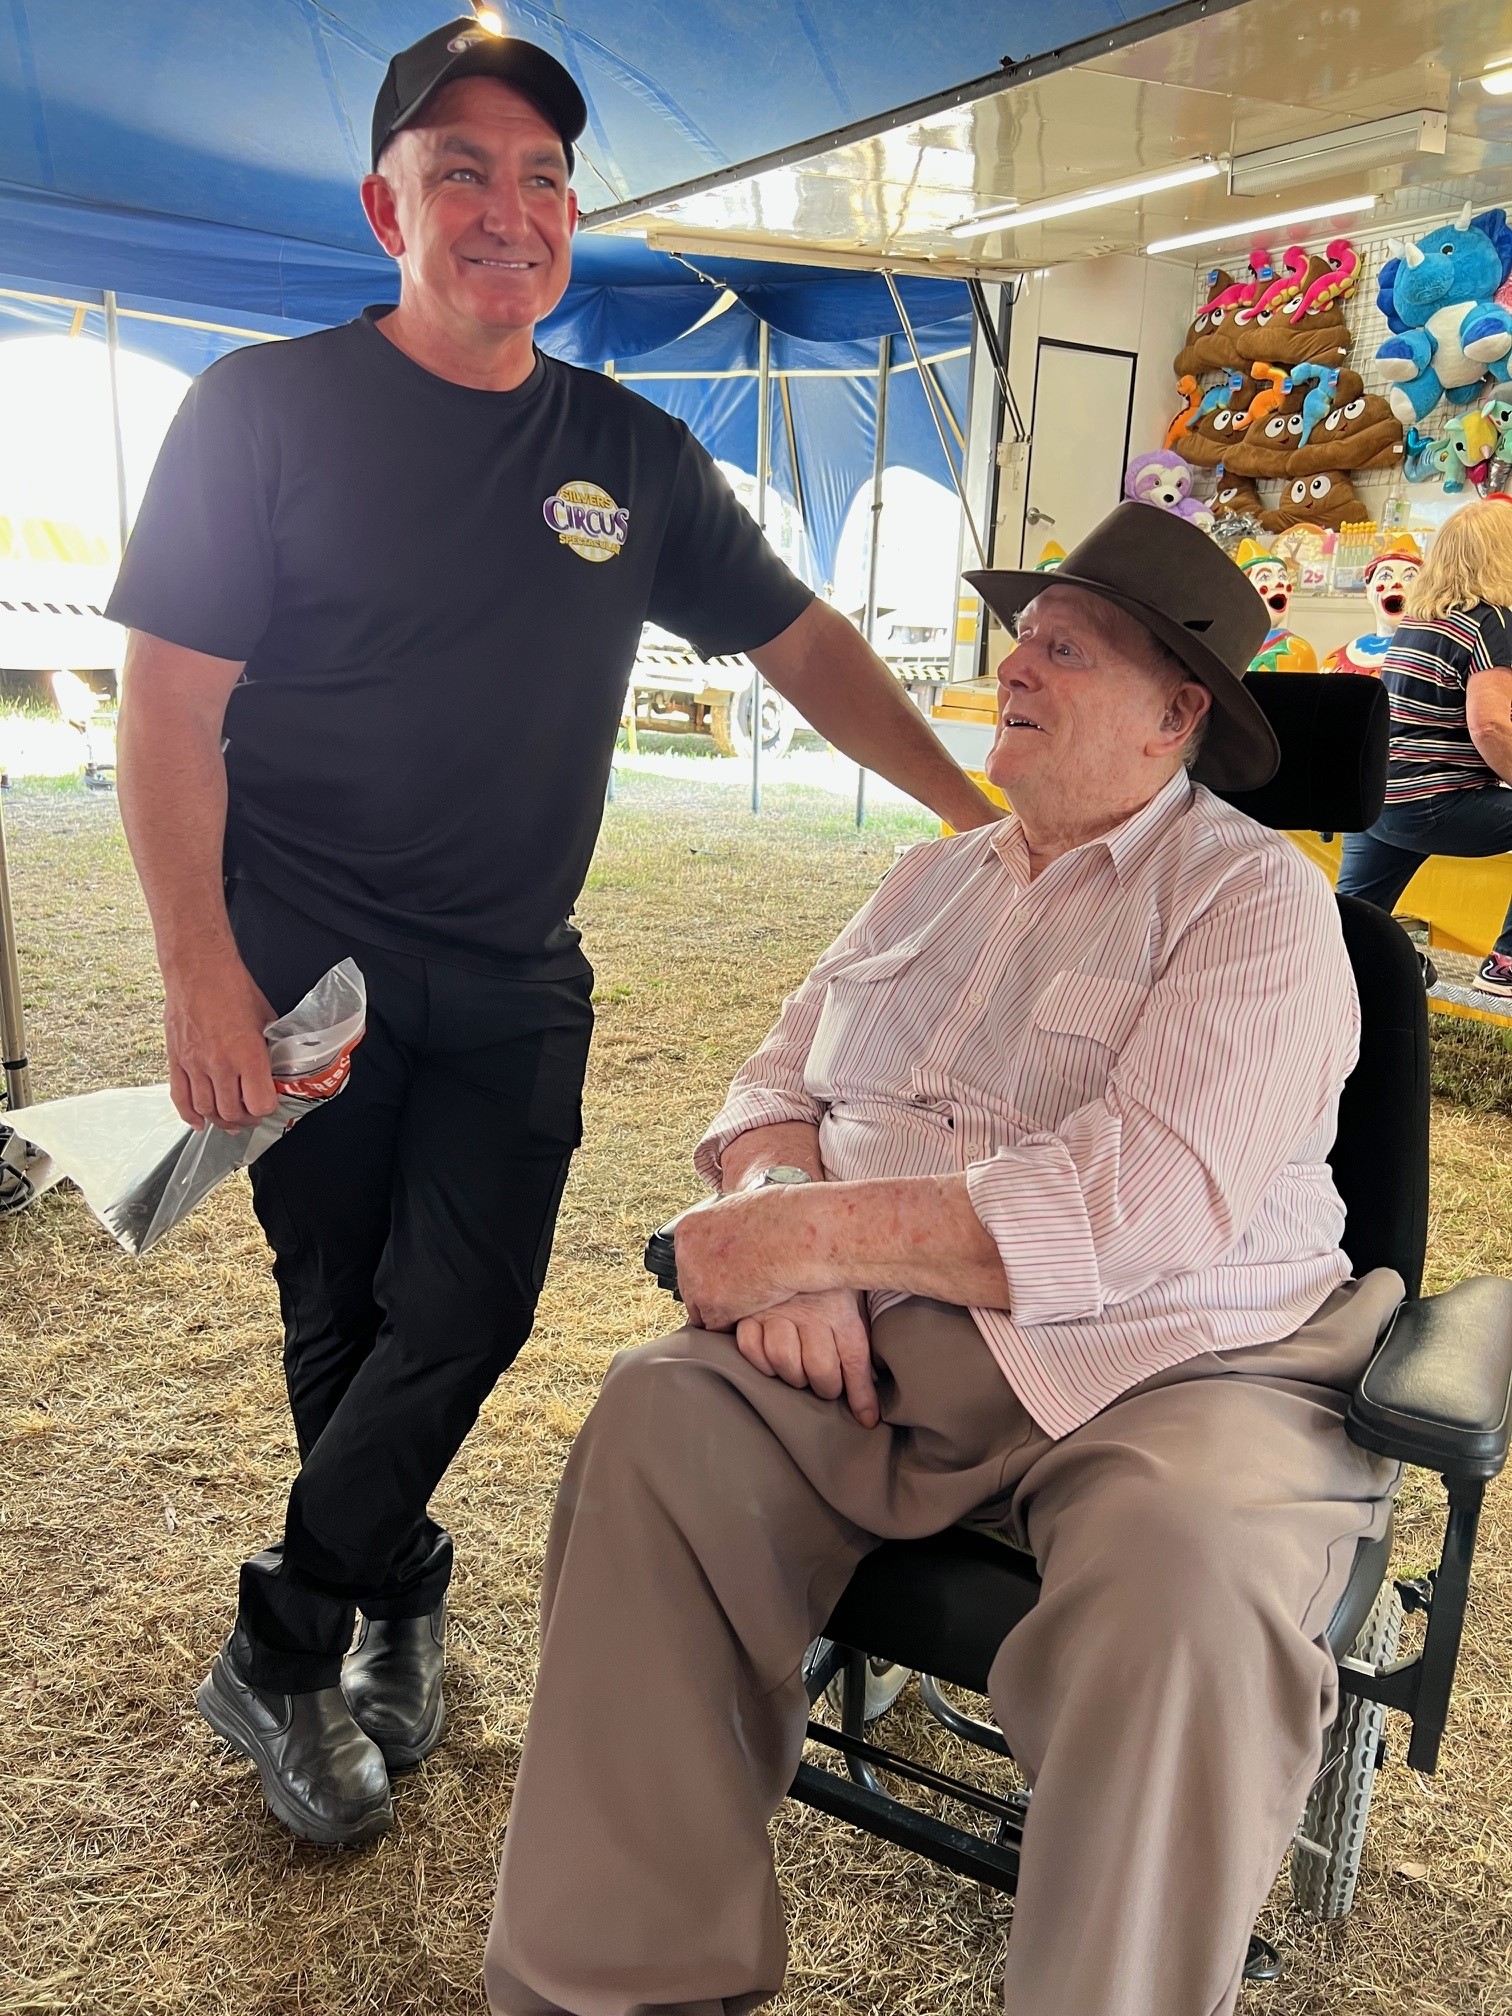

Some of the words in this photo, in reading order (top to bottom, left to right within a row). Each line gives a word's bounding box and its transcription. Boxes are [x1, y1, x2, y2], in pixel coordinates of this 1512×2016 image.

[561, 489, 612, 510] SILVERS
[543, 495, 629, 545] CIRCUS
[558, 533, 621, 556] SPECTACULAR
